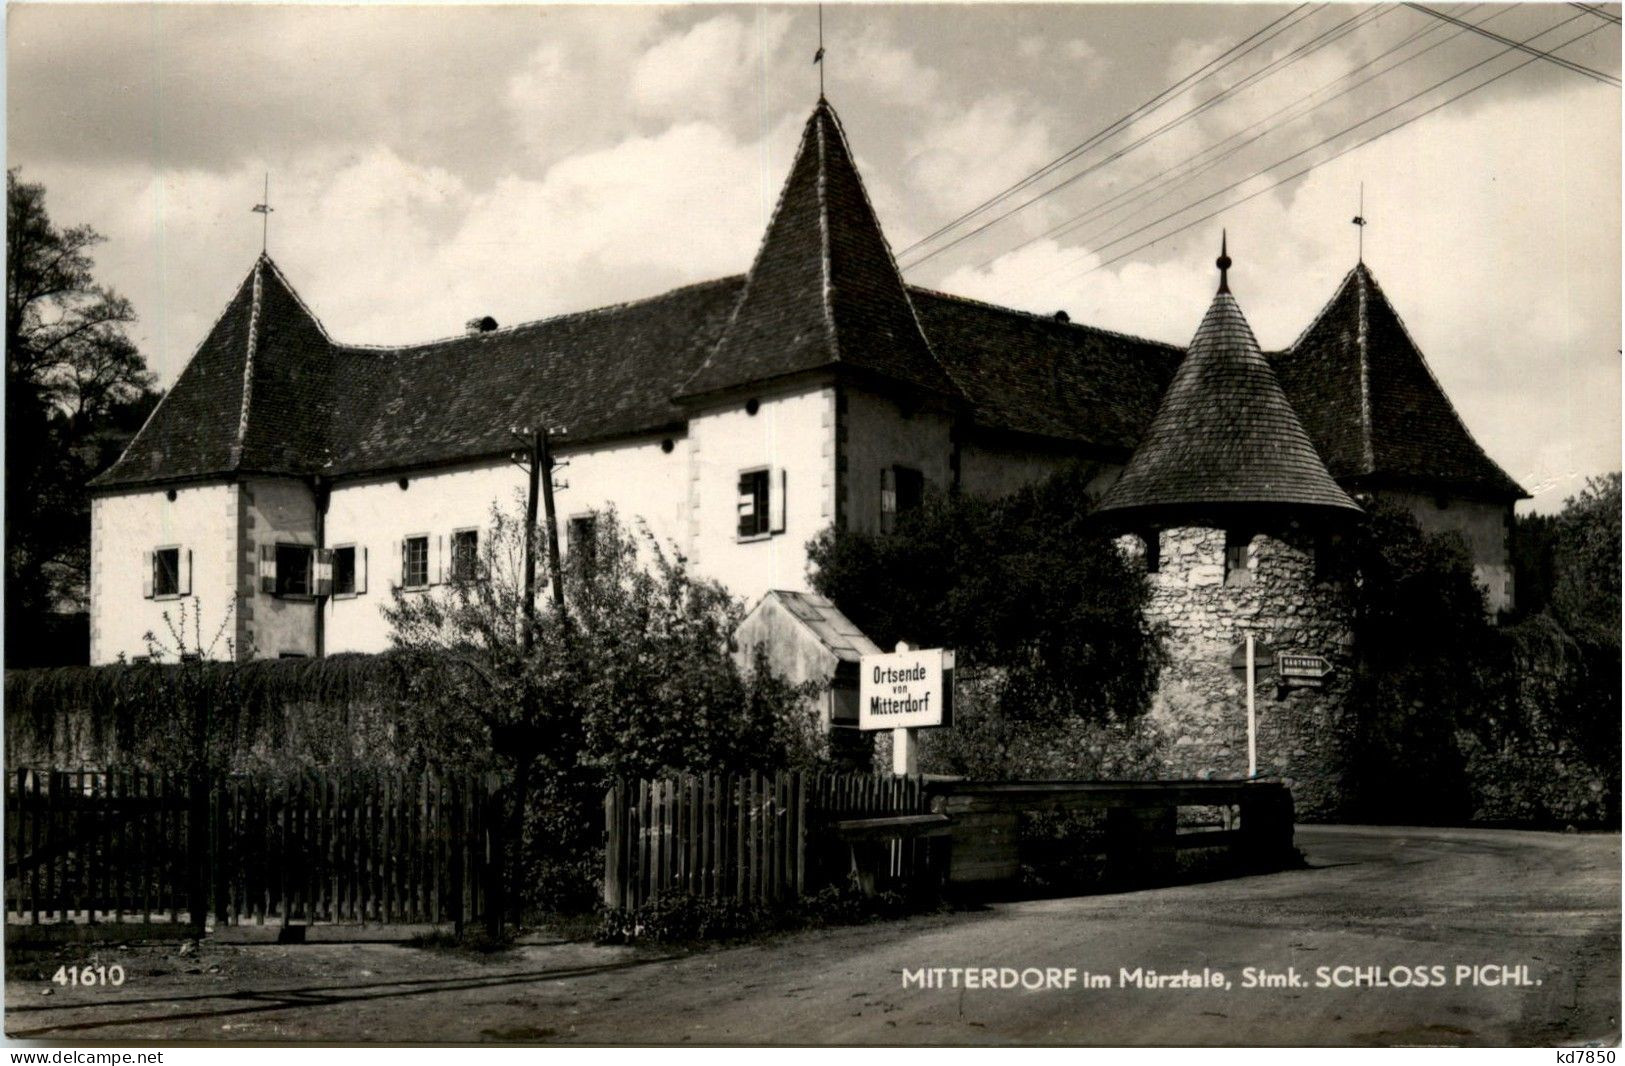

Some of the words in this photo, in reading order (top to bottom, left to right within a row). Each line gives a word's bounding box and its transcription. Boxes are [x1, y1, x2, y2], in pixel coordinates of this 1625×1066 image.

[873, 662, 926, 684] Ortsende
[893, 685, 908, 694] von
[870, 692, 930, 715] Mitterdorf
